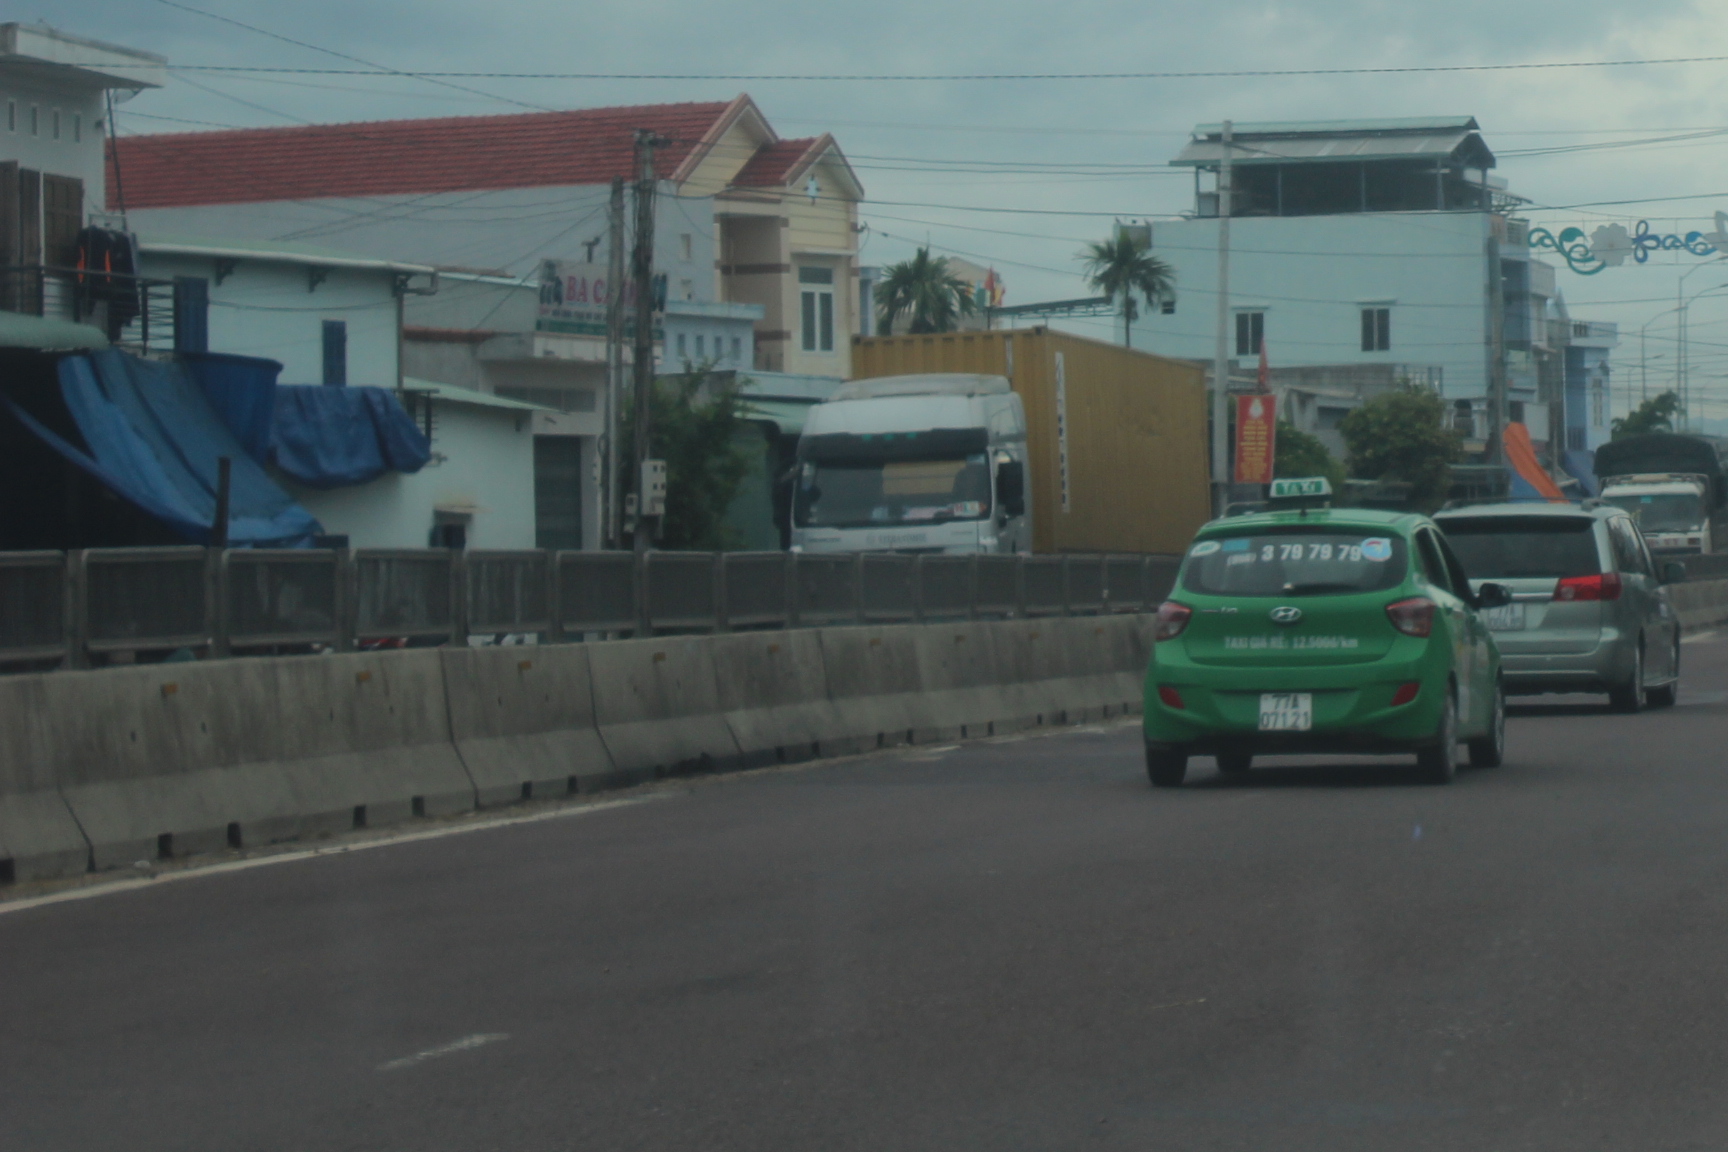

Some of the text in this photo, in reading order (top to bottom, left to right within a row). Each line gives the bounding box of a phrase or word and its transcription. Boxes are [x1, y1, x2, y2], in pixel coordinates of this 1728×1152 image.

[1281, 480, 1318, 496] TAXI
[1261, 544, 1275, 562] 3
[1279, 544, 1304, 561] 79
[1308, 543, 1333, 560] 79
[1337, 544, 1362, 562] 79
